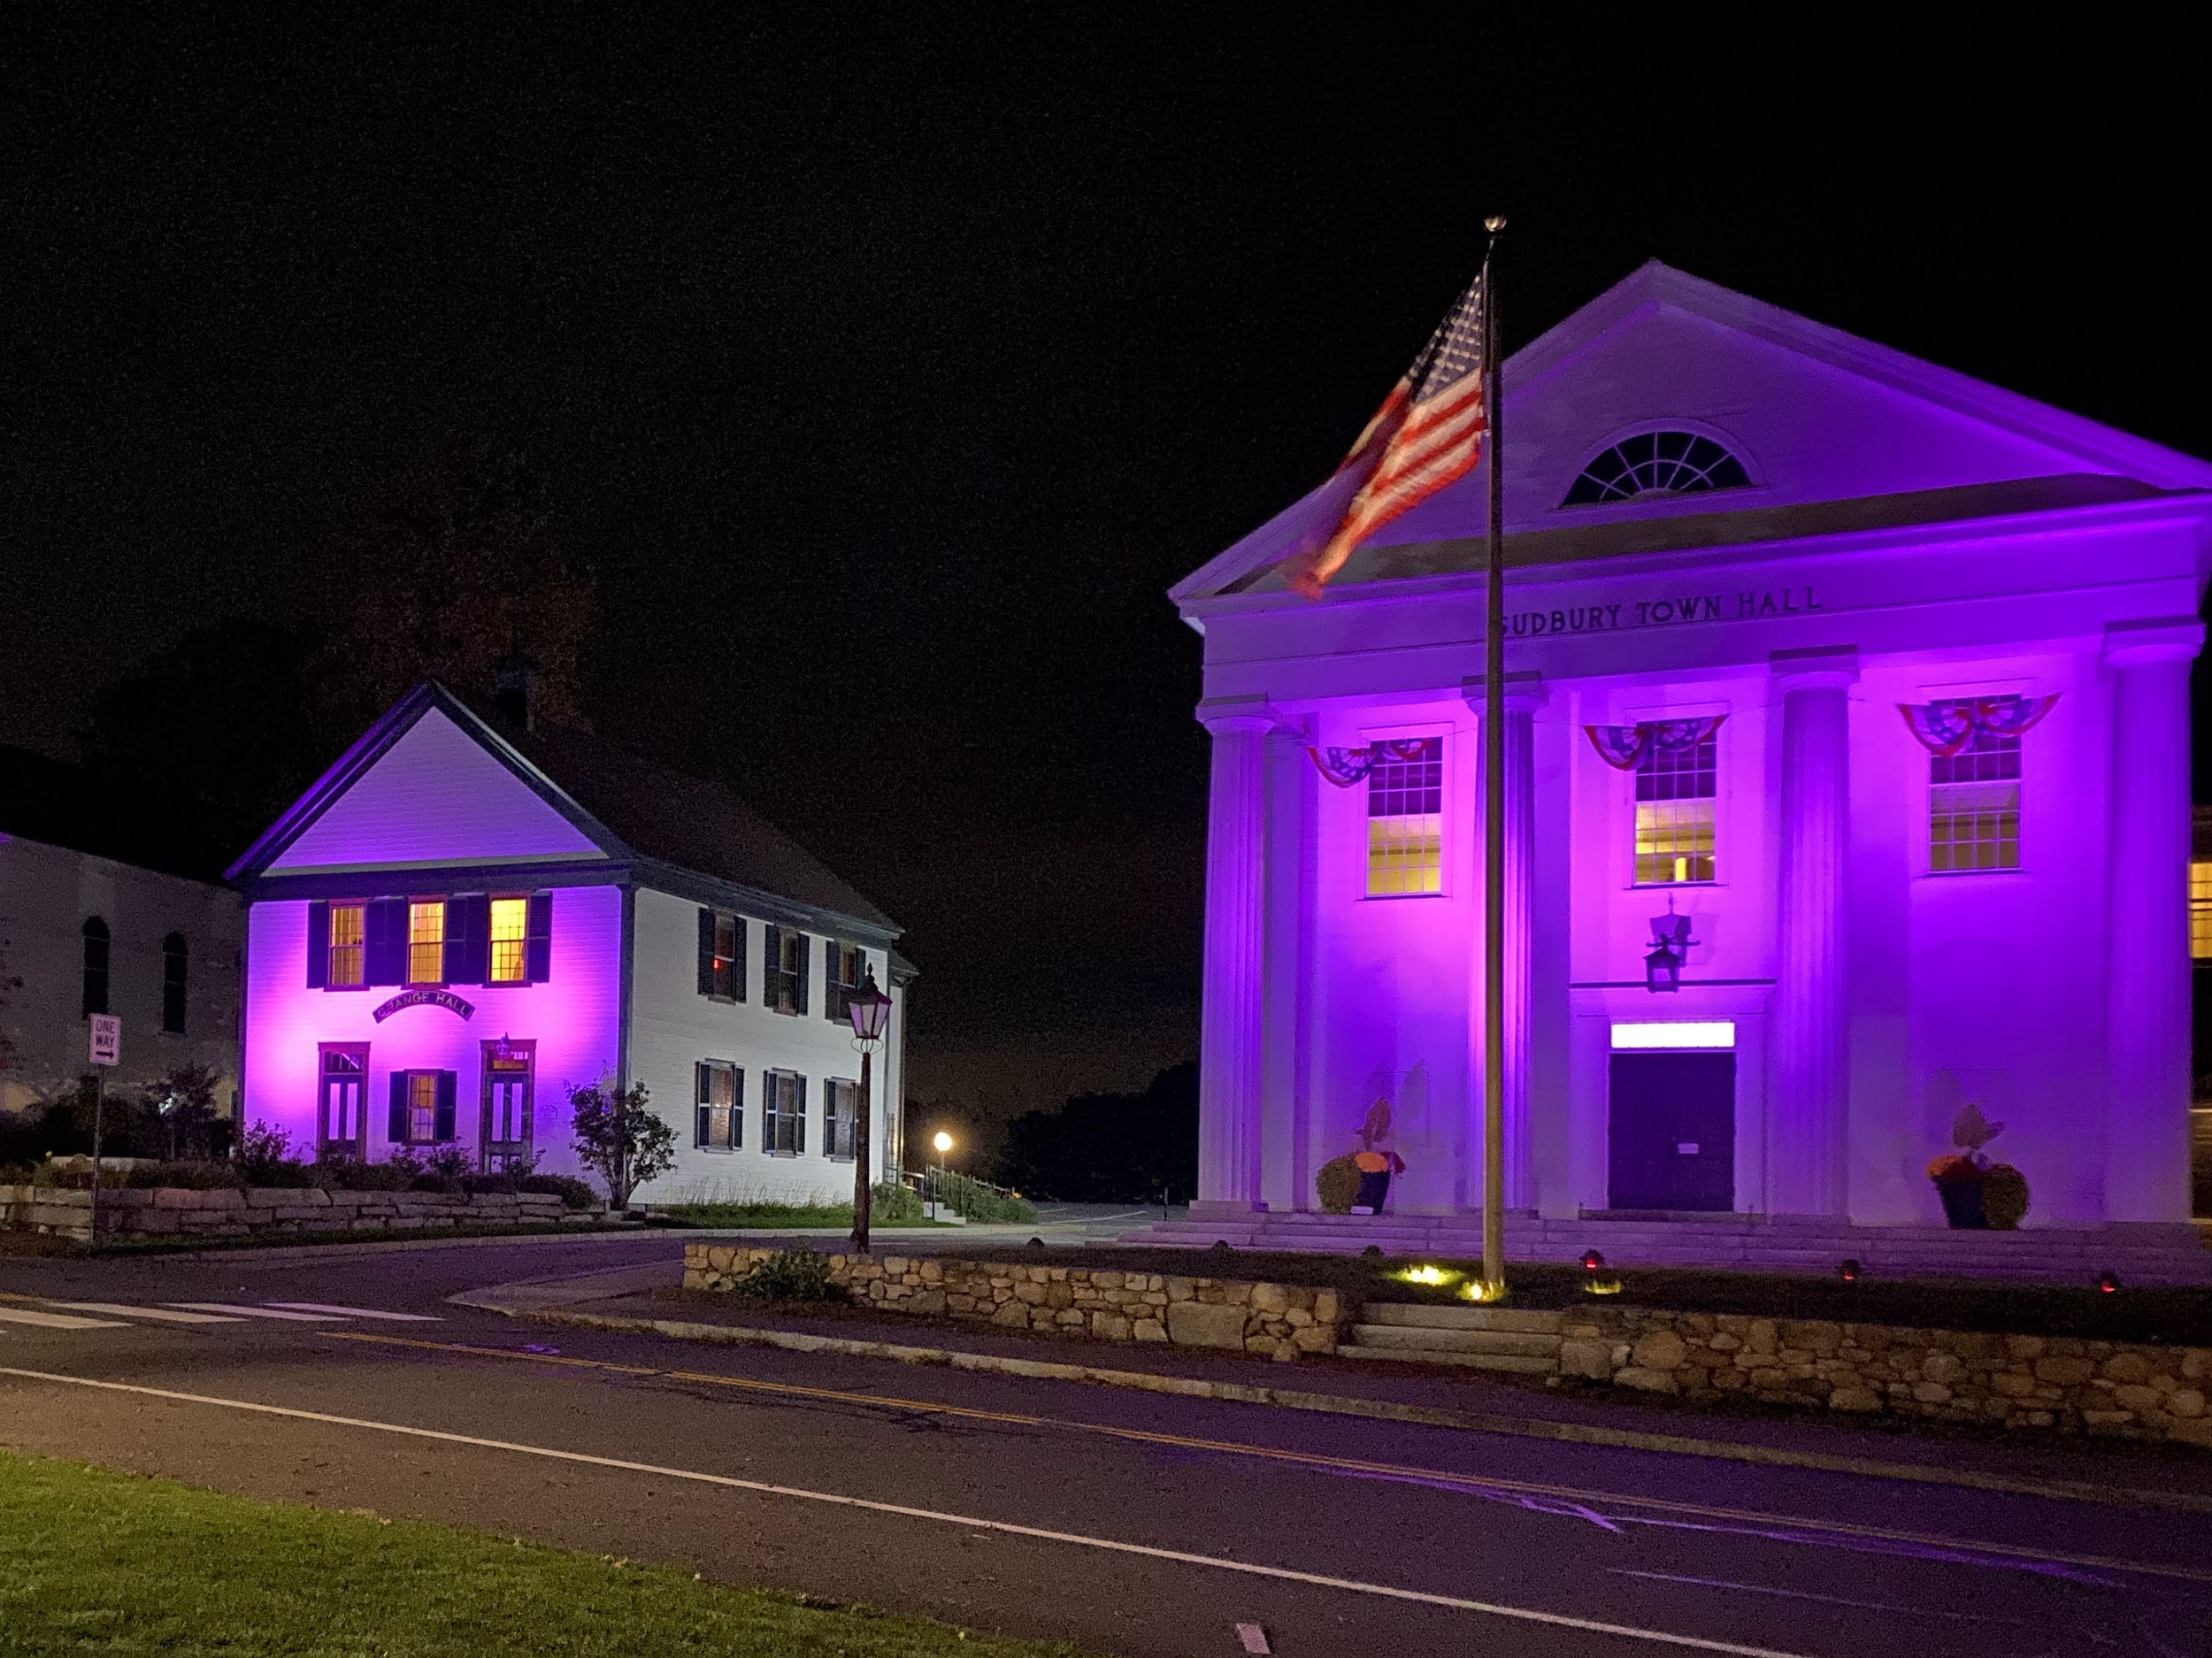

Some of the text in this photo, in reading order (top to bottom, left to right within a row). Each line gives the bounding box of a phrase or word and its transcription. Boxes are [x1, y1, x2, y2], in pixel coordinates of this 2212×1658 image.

[1637, 595, 1720, 624] TOWN
[1738, 587, 1823, 615] HALL
[377, 993, 466, 1017] GRANGE HALL
[96, 1019, 115, 1033] ONE
[96, 1034, 115, 1048] WAY
